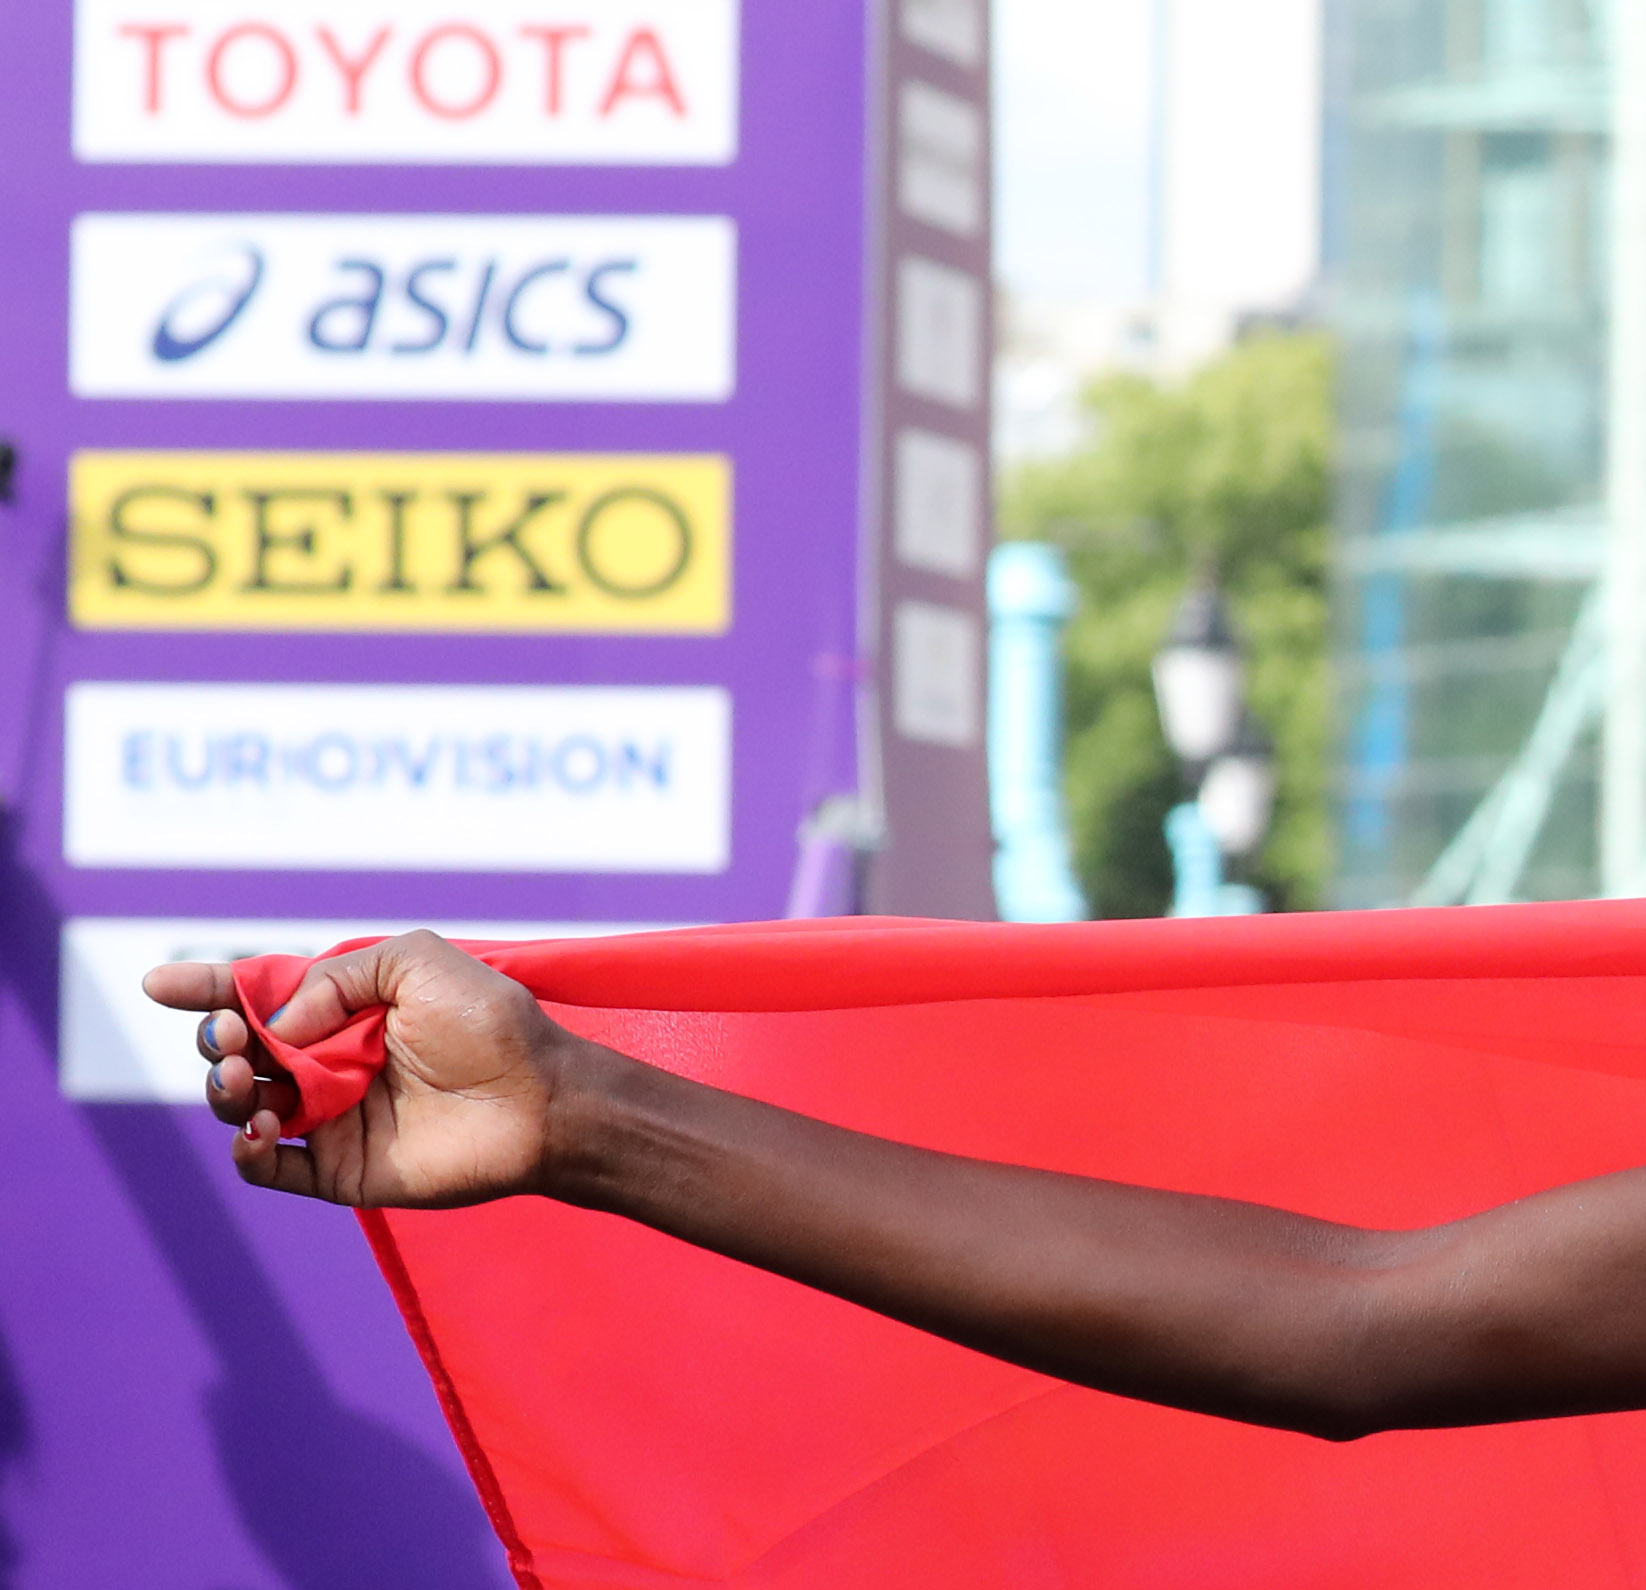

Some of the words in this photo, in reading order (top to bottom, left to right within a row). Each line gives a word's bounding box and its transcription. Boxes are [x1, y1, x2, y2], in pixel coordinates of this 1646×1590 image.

[118, 22, 690, 121] TOYOTA
[306, 258, 640, 356] asics
[106, 485, 694, 600] SEIKO
[122, 730, 673, 792] EUROVISION
